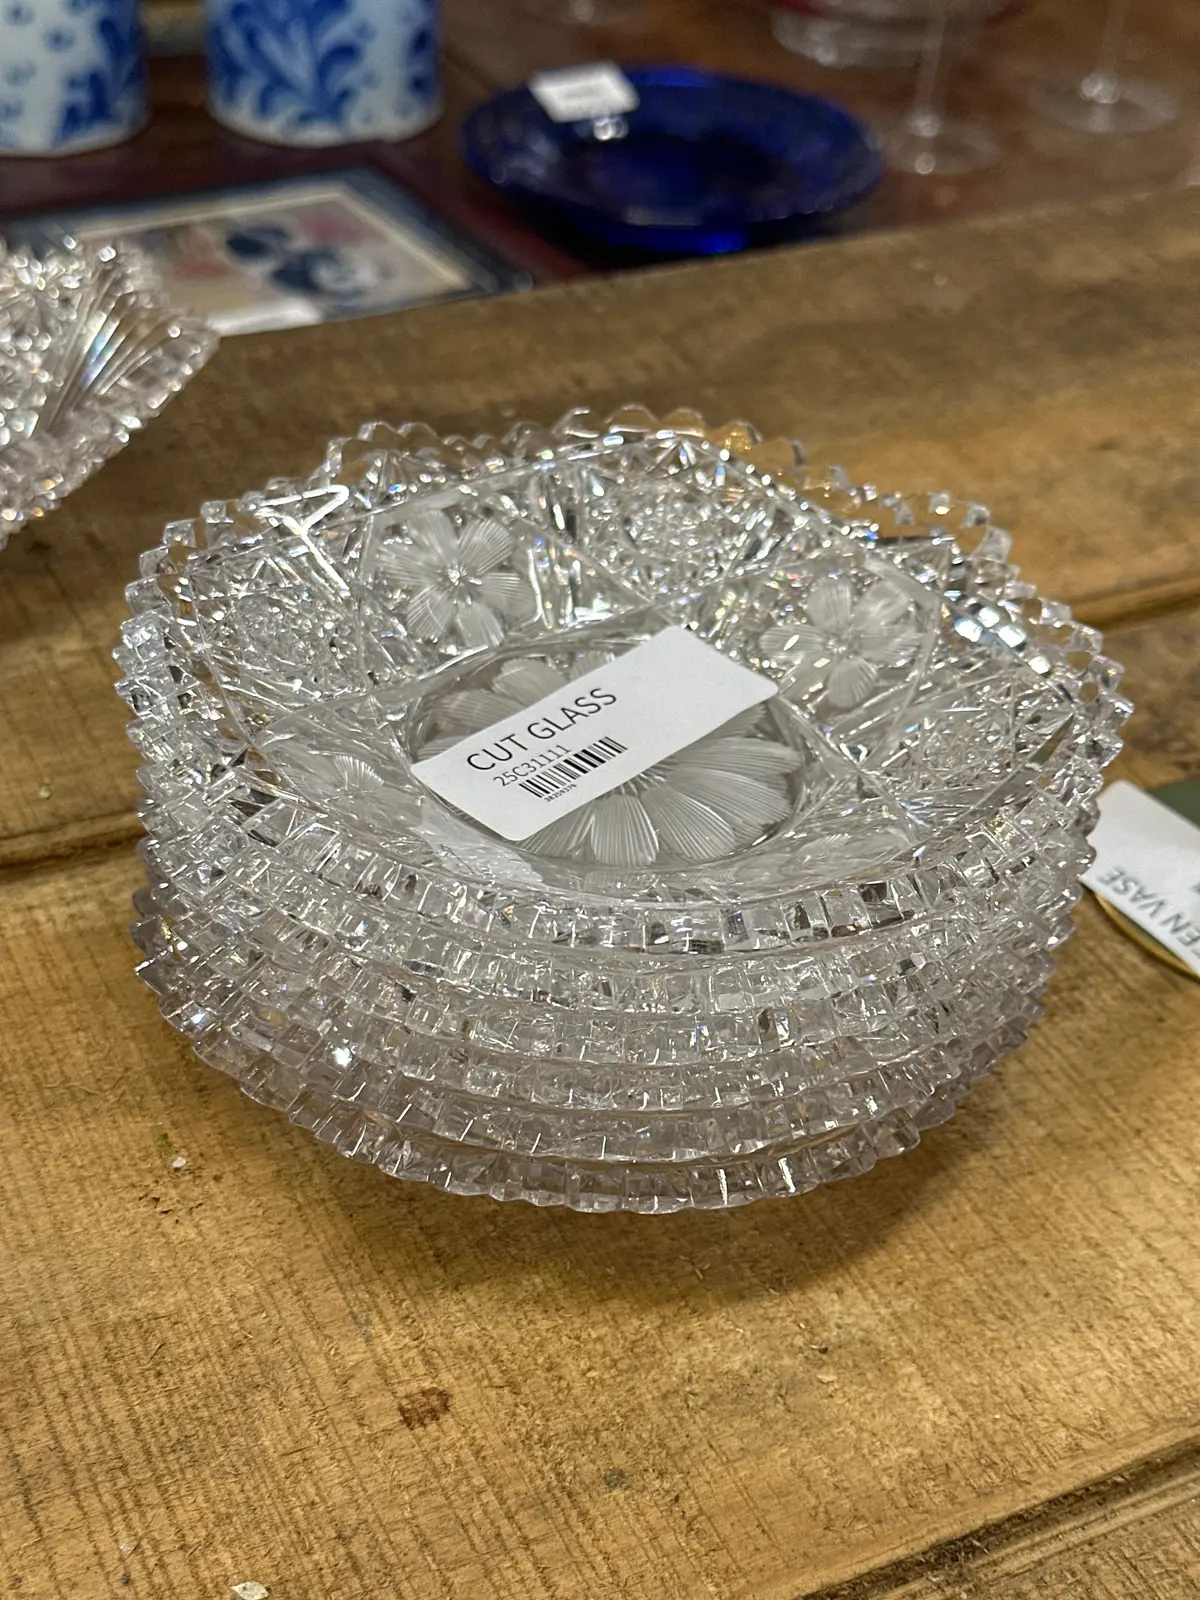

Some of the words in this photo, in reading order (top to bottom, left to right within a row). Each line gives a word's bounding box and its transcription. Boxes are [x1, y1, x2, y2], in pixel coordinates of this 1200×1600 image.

[467, 733, 528, 771] CUT
[527, 688, 617, 740] GLASS
[493, 744, 571, 787] 25C31111
[1098, 866, 1165, 918] VASE
[1160, 912, 1200, 959] EN
